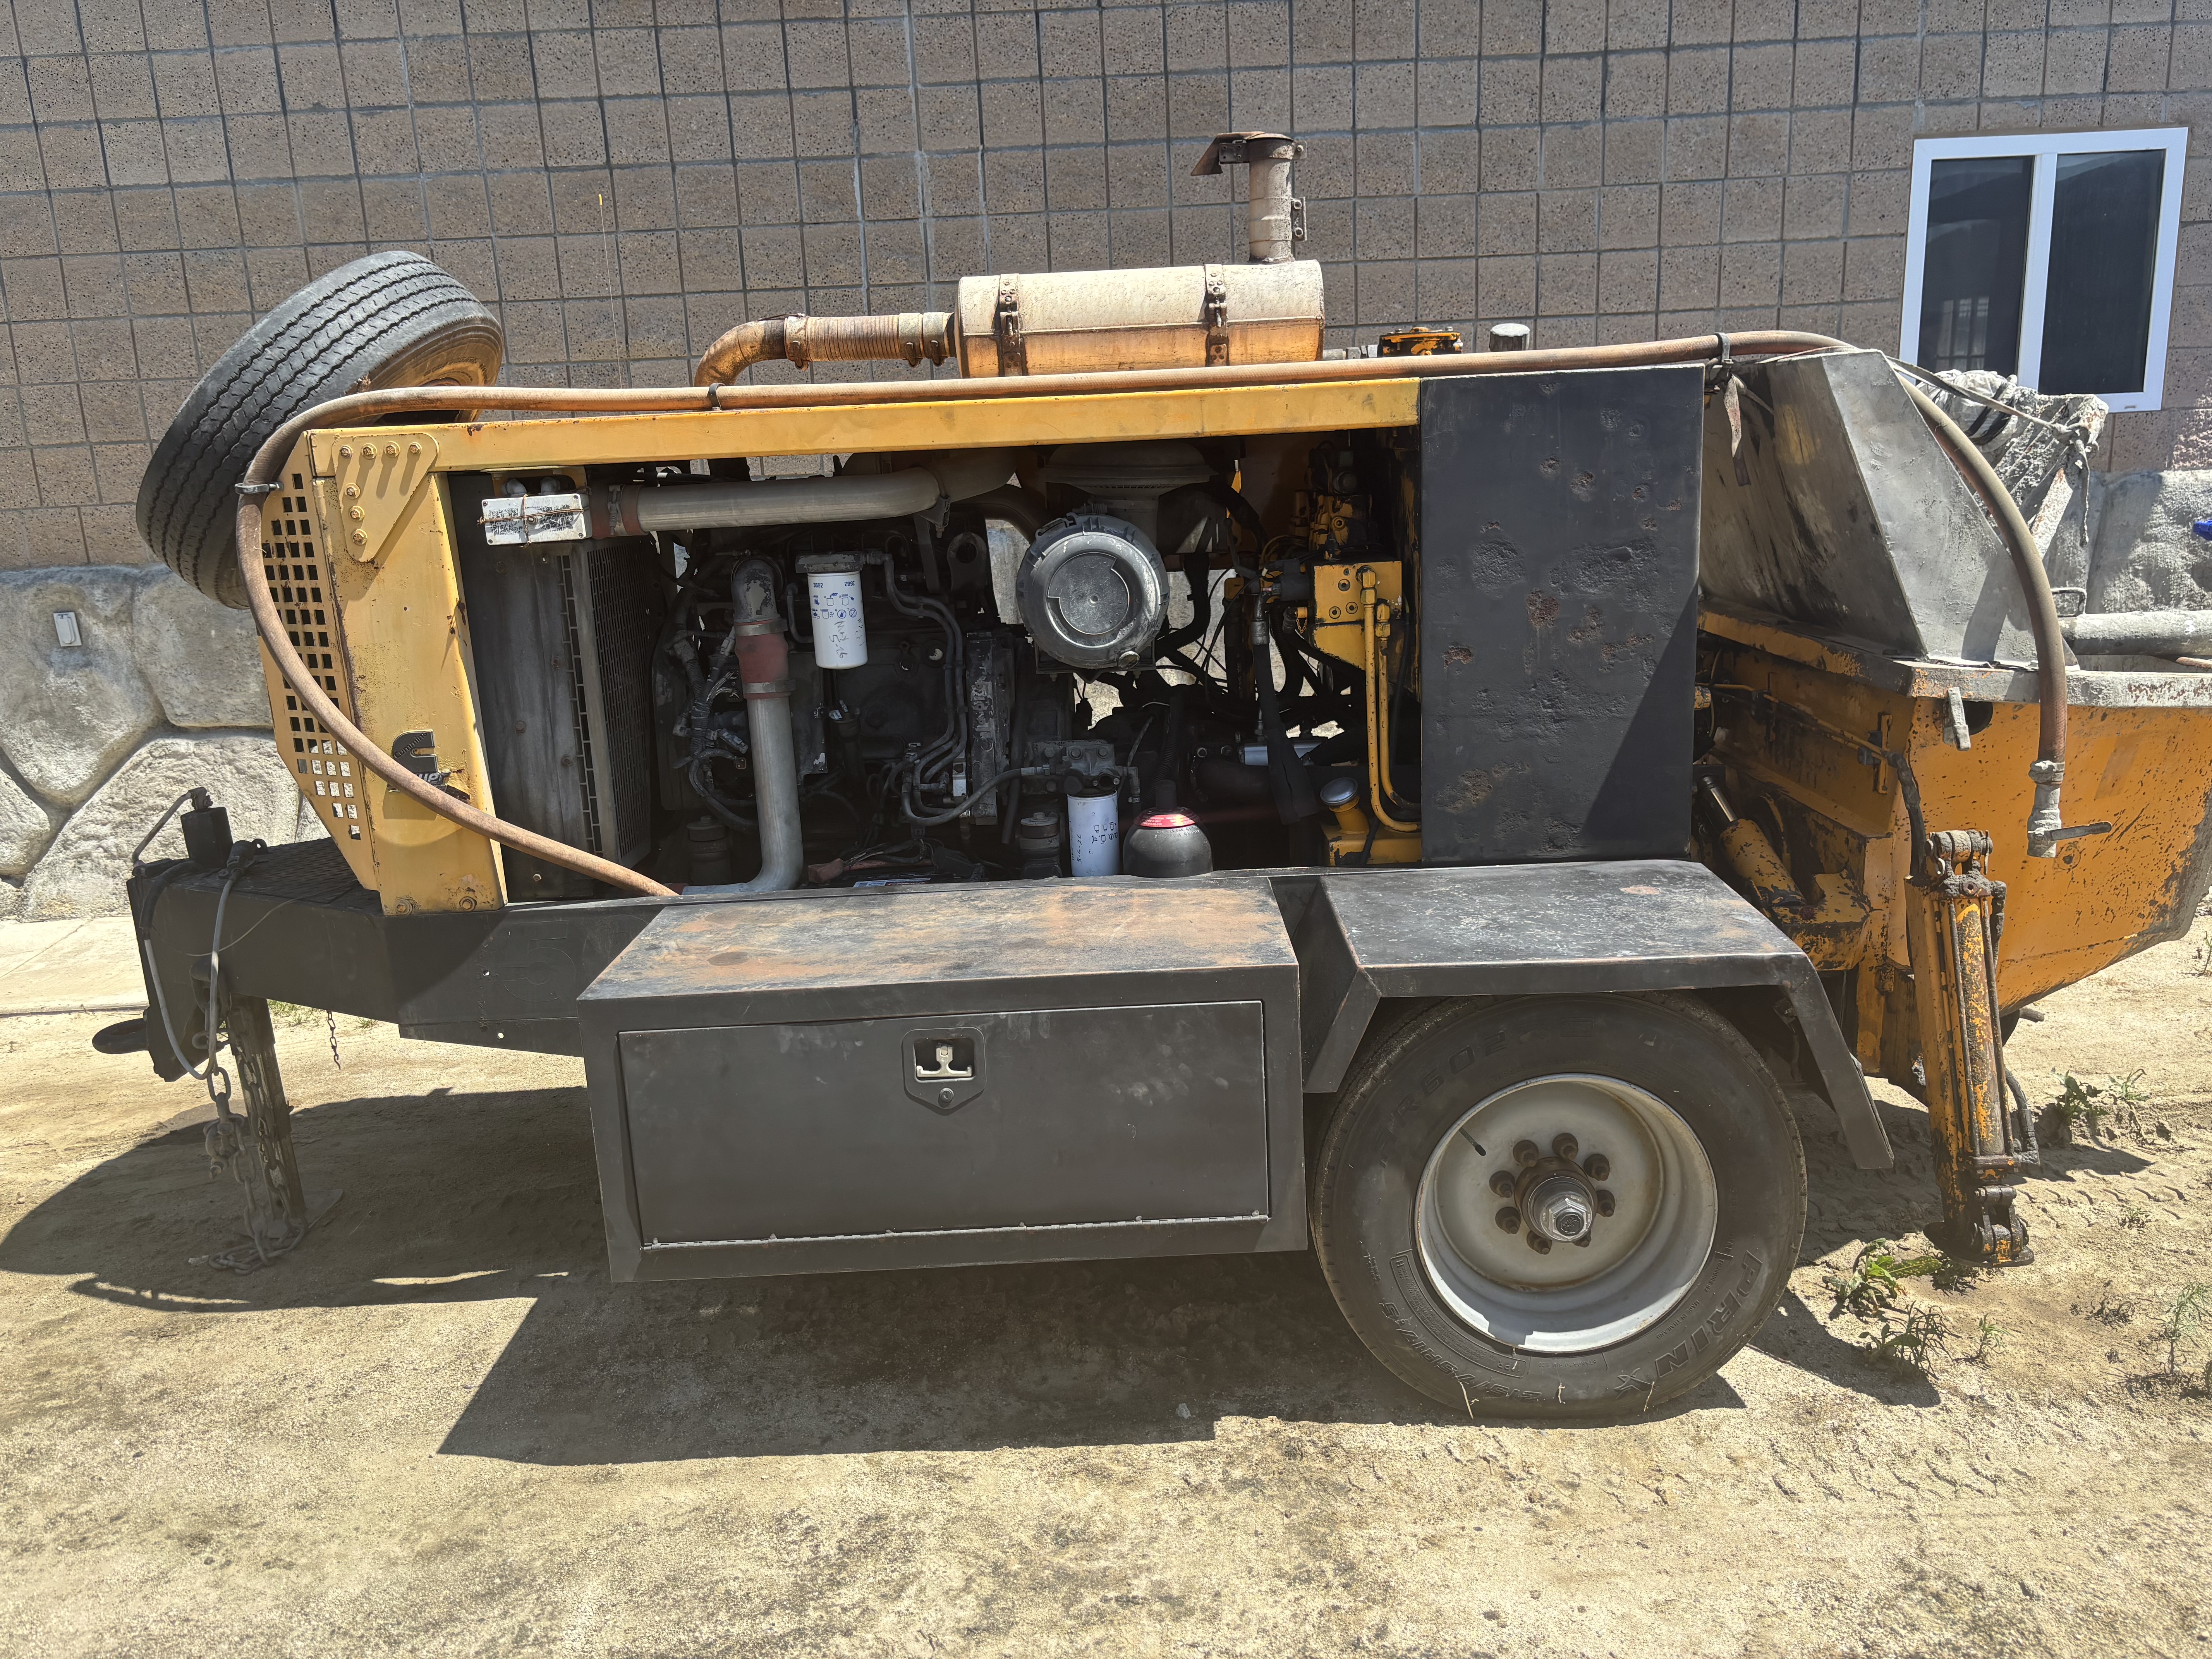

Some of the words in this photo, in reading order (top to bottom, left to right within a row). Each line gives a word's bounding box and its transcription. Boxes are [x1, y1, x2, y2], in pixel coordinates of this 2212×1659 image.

[394, 732, 428, 759] Cummins
[1686, 1300, 1700, 1314] MADE
[1614, 1250, 1763, 1400] PRINX
[1657, 1319, 1682, 1339] THAILAND
[1565, 1359, 1597, 1368] STANDARD
